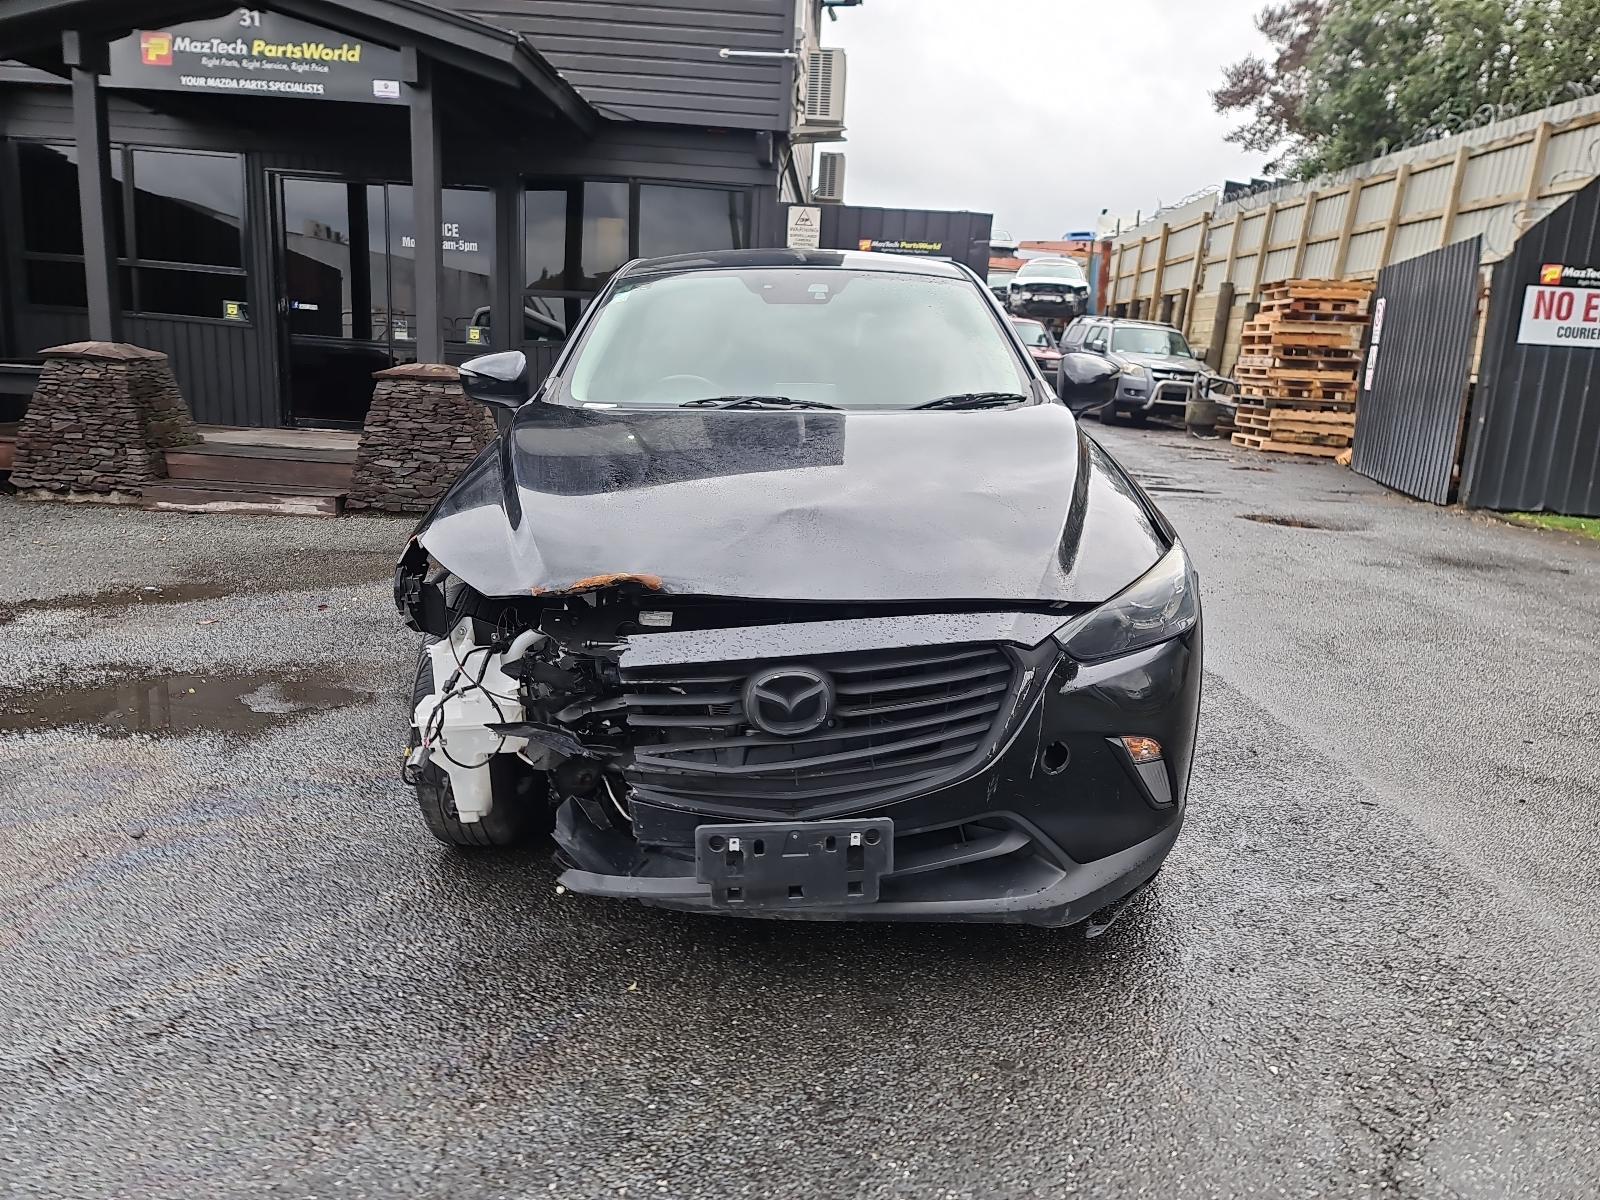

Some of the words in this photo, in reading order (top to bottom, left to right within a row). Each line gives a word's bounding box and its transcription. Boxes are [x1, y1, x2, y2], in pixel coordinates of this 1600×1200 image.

[239, 8, 260, 27] 31
[173, 37, 247, 55] MazTech
[252, 39, 361, 62] PartsWorld
[180, 75, 206, 86] YOUR
[206, 77, 238, 89] MAZDA
[239, 80, 268, 91] PARTS
[269, 81, 325, 94] SPECIALISTS
[1562, 266, 1600, 279] MazTec
[1533, 290, 1575, 321] NO
[1582, 292, 1600, 323] E
